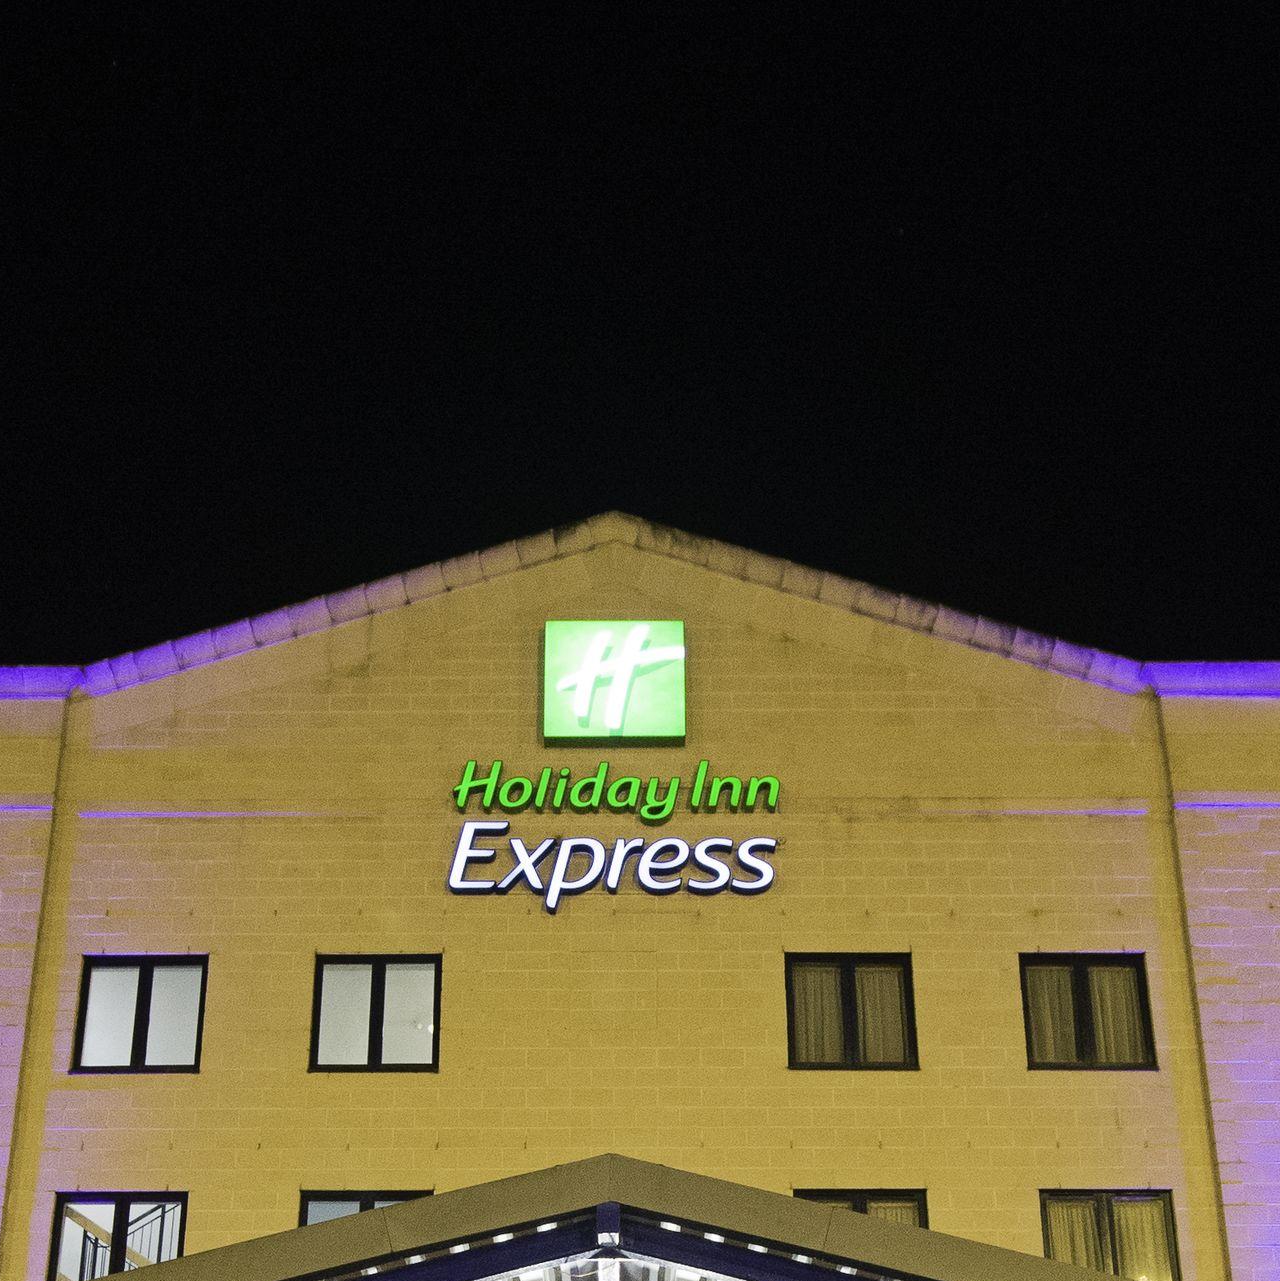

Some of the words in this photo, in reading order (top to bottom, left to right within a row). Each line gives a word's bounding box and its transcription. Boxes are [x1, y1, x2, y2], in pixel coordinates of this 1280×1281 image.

[454, 760, 681, 822] Holiday
[690, 760, 781, 811] Inn
[448, 820, 778, 914] Express
